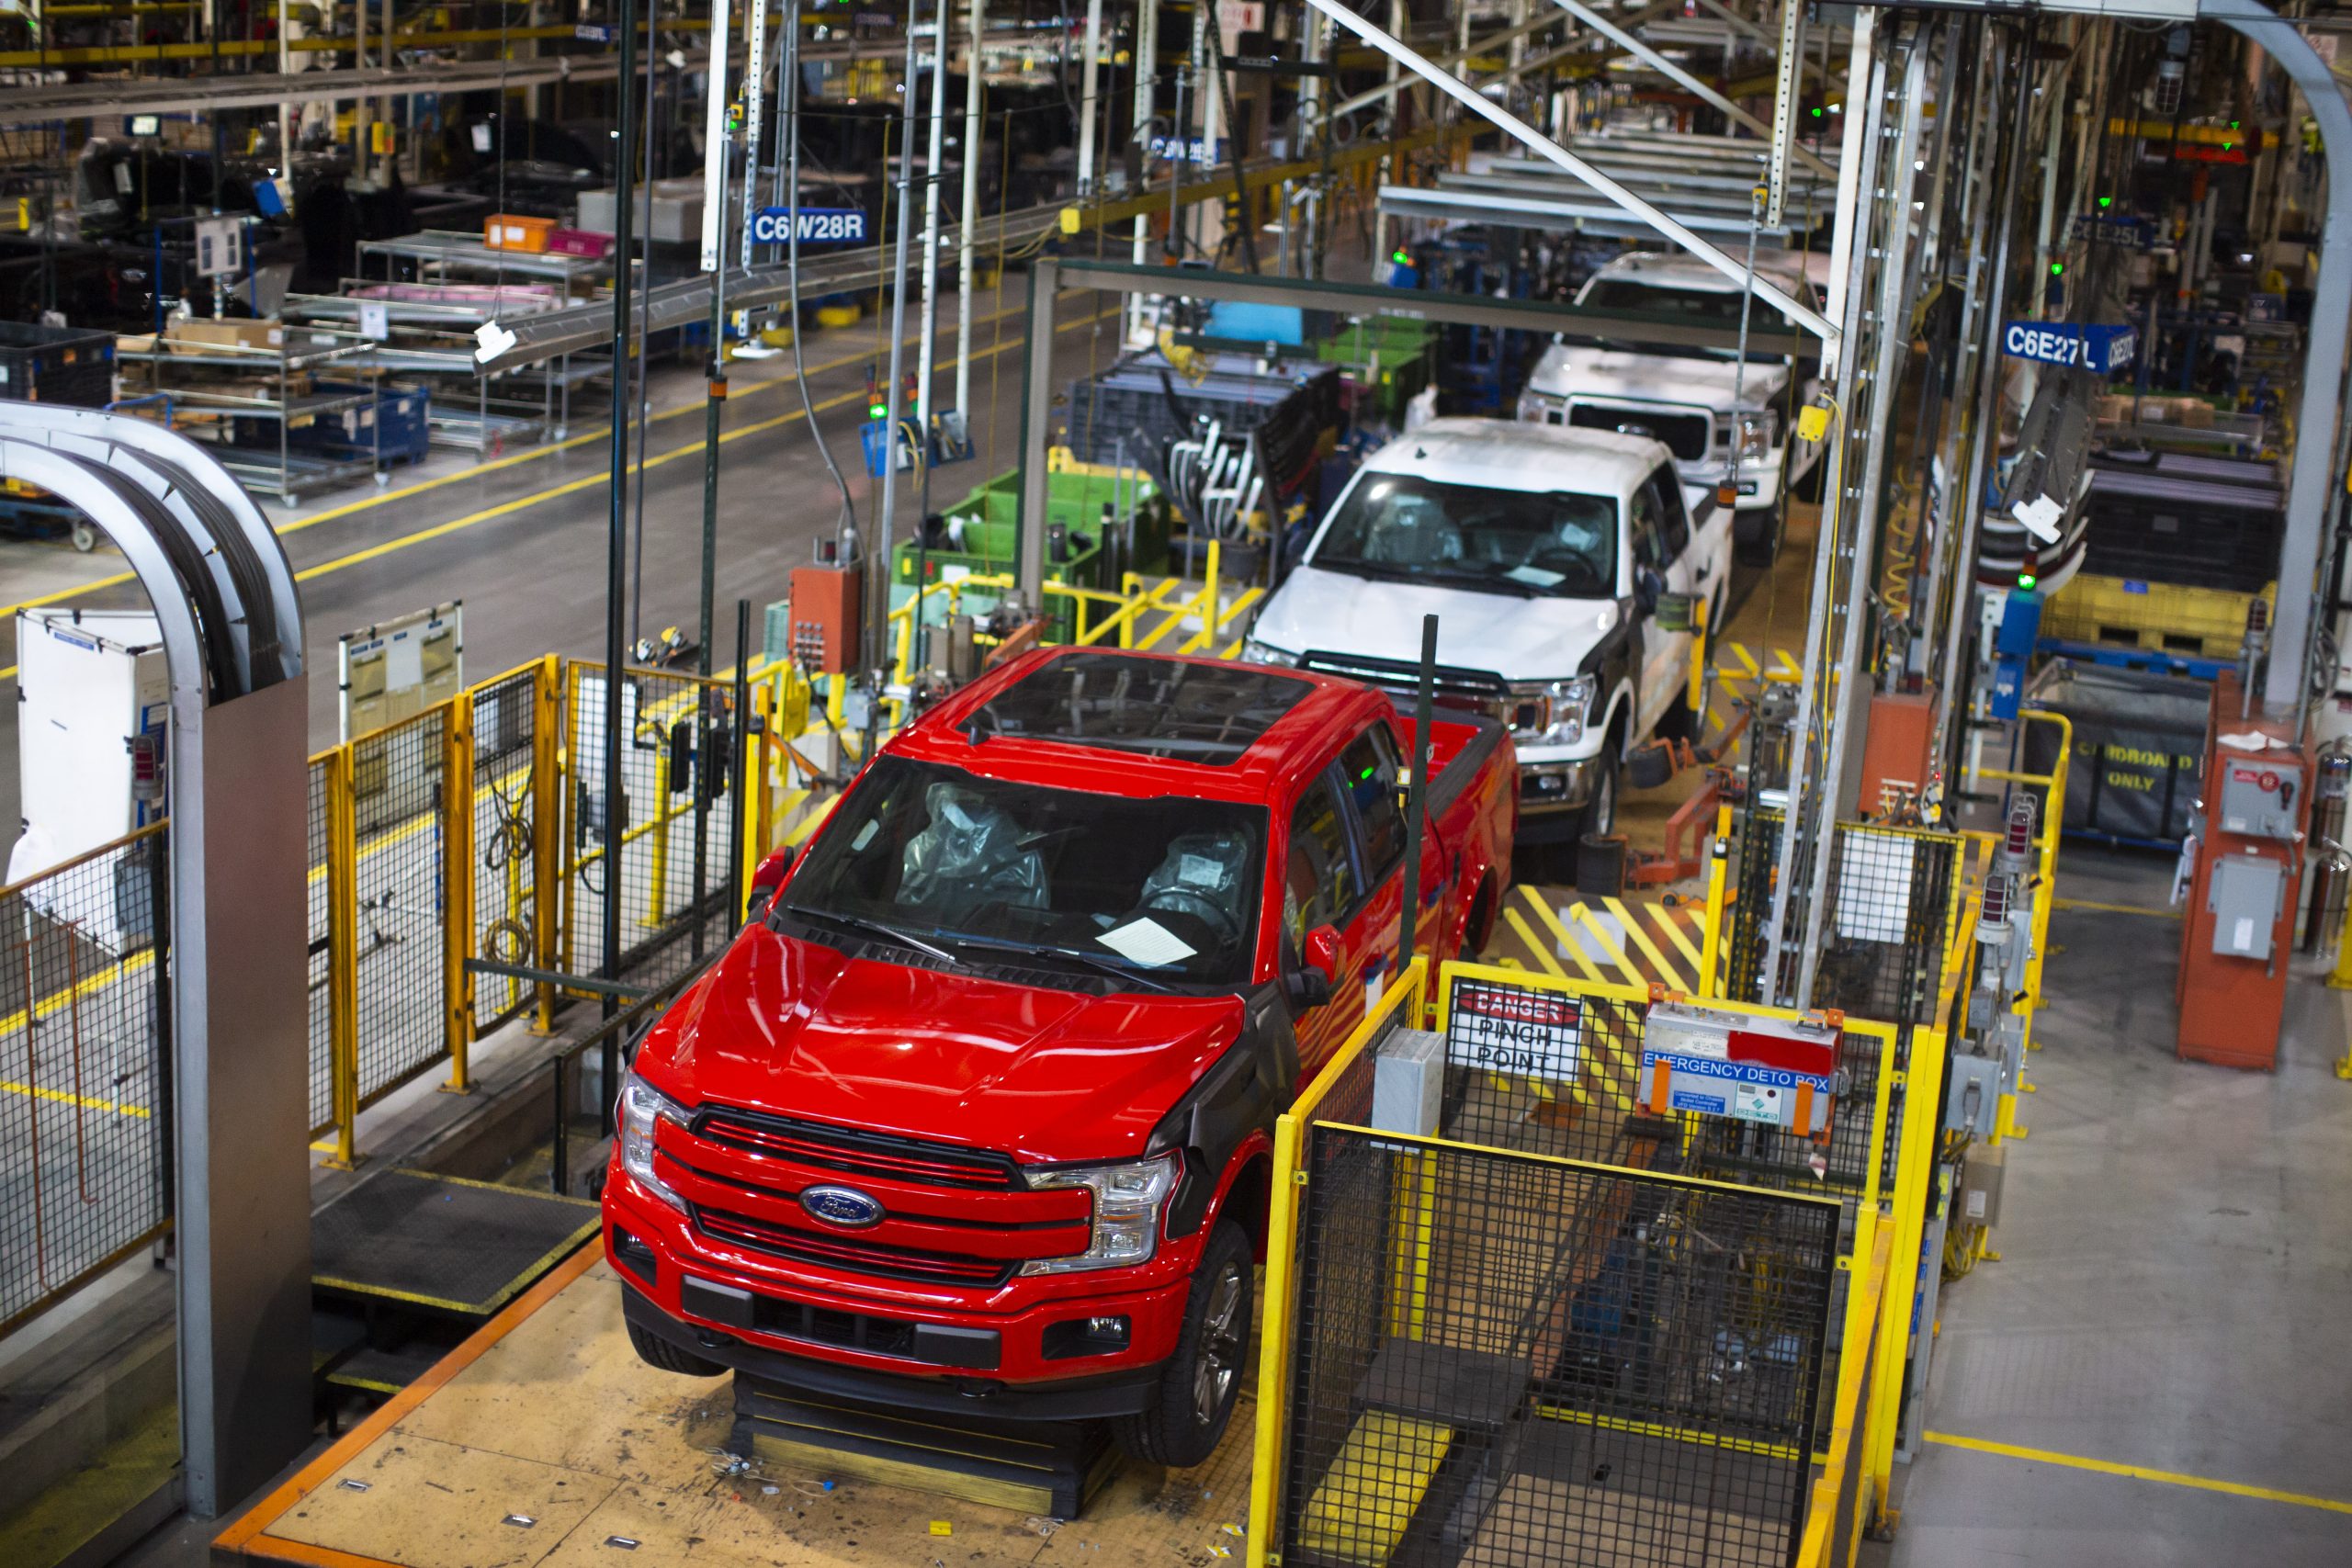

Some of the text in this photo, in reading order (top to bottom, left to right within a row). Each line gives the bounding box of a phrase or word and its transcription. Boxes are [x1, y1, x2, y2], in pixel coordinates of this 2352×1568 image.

[754, 213, 864, 241] C6W28R
[2007, 325, 2097, 369] C6E27L
[2108, 772, 2155, 792] ONLY
[1476, 993, 1560, 1021] DANGER
[1478, 1019, 1553, 1046] PINCH
[1747, 1067, 1792, 1086] DETO
[820, 1196, 859, 1219] Ford
